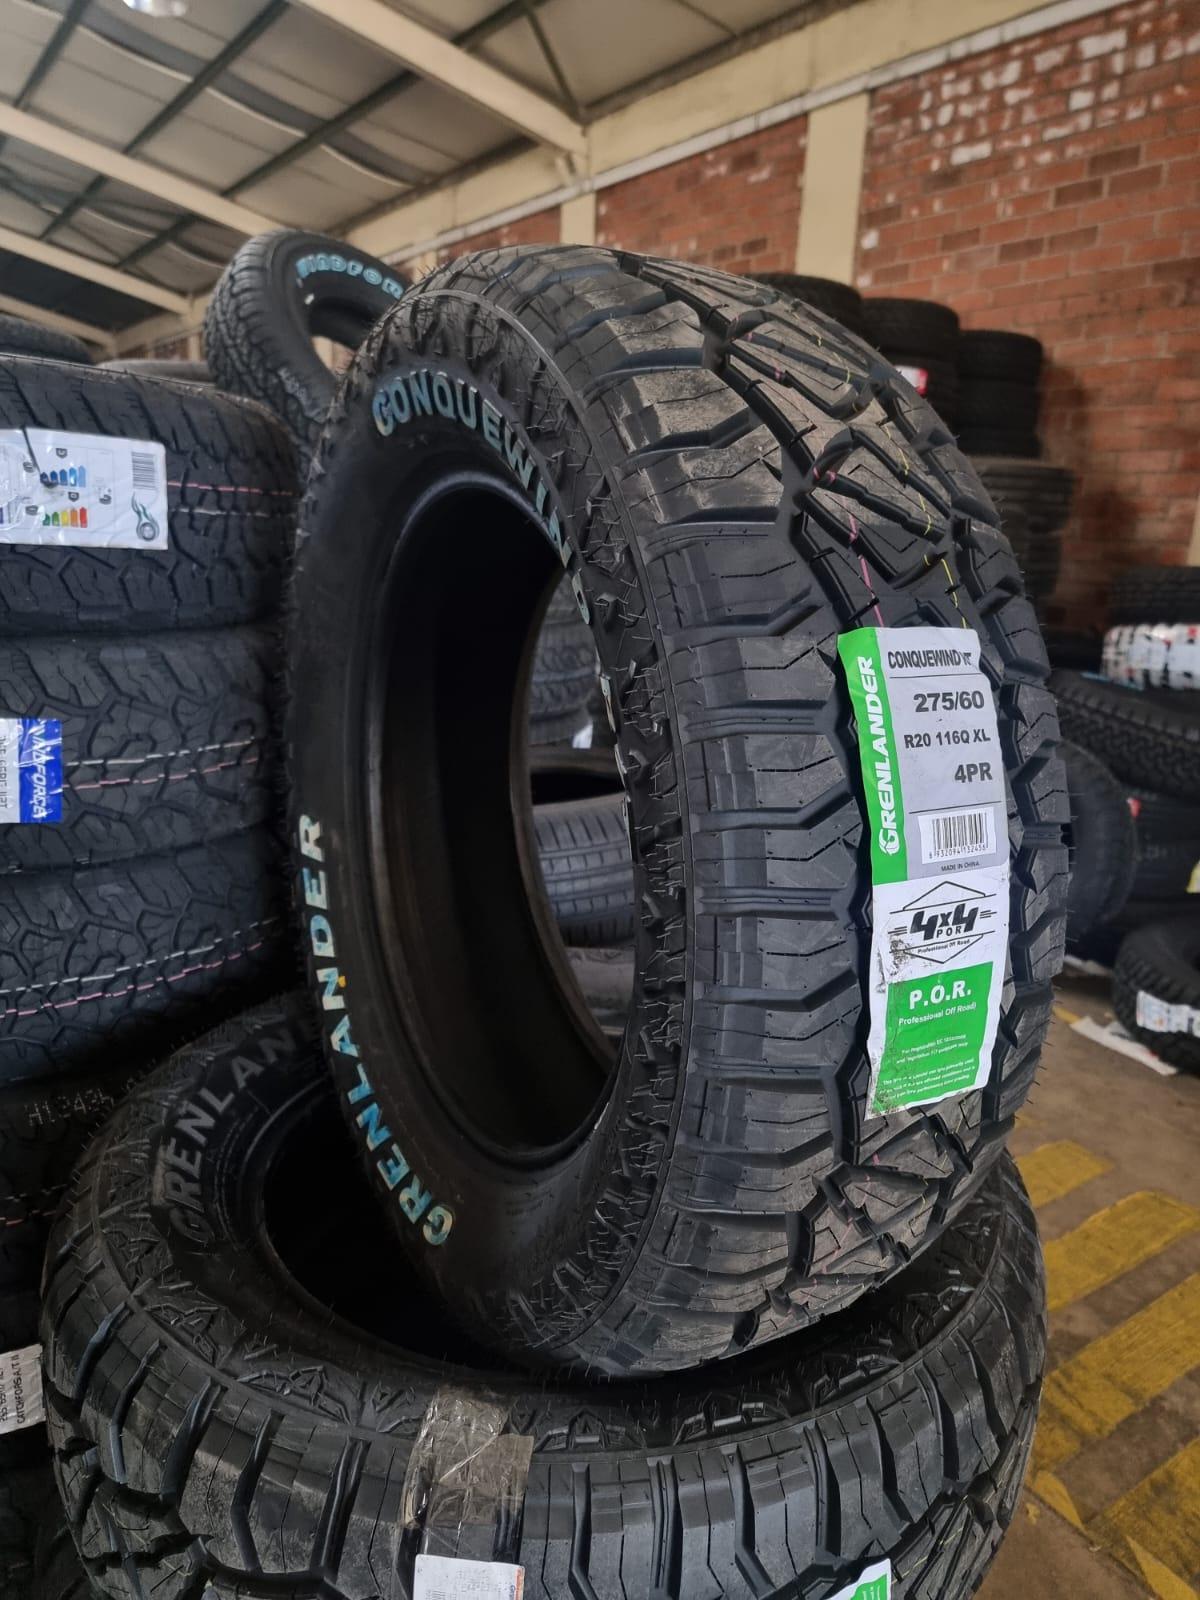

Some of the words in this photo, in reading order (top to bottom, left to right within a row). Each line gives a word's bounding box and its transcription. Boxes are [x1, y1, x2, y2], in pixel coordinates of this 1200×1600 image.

[887, 649, 962, 670] CONQUEWIND
[913, 690, 985, 713] 275/60
[904, 733, 931, 749] R20
[935, 730, 970, 747] 116Q
[973, 728, 991, 743] XL
[857, 655, 900, 857] GRENLANDER
[954, 761, 993, 784] 4PR
[936, 925, 962, 939] POR
[909, 980, 971, 1010] P.O.R.
[898, 1011, 944, 1026] Professional
[945, 1007, 957, 1017] Off
[957, 1002, 977, 1014] Road
[299, 814, 454, 1246] GRENLANDER
